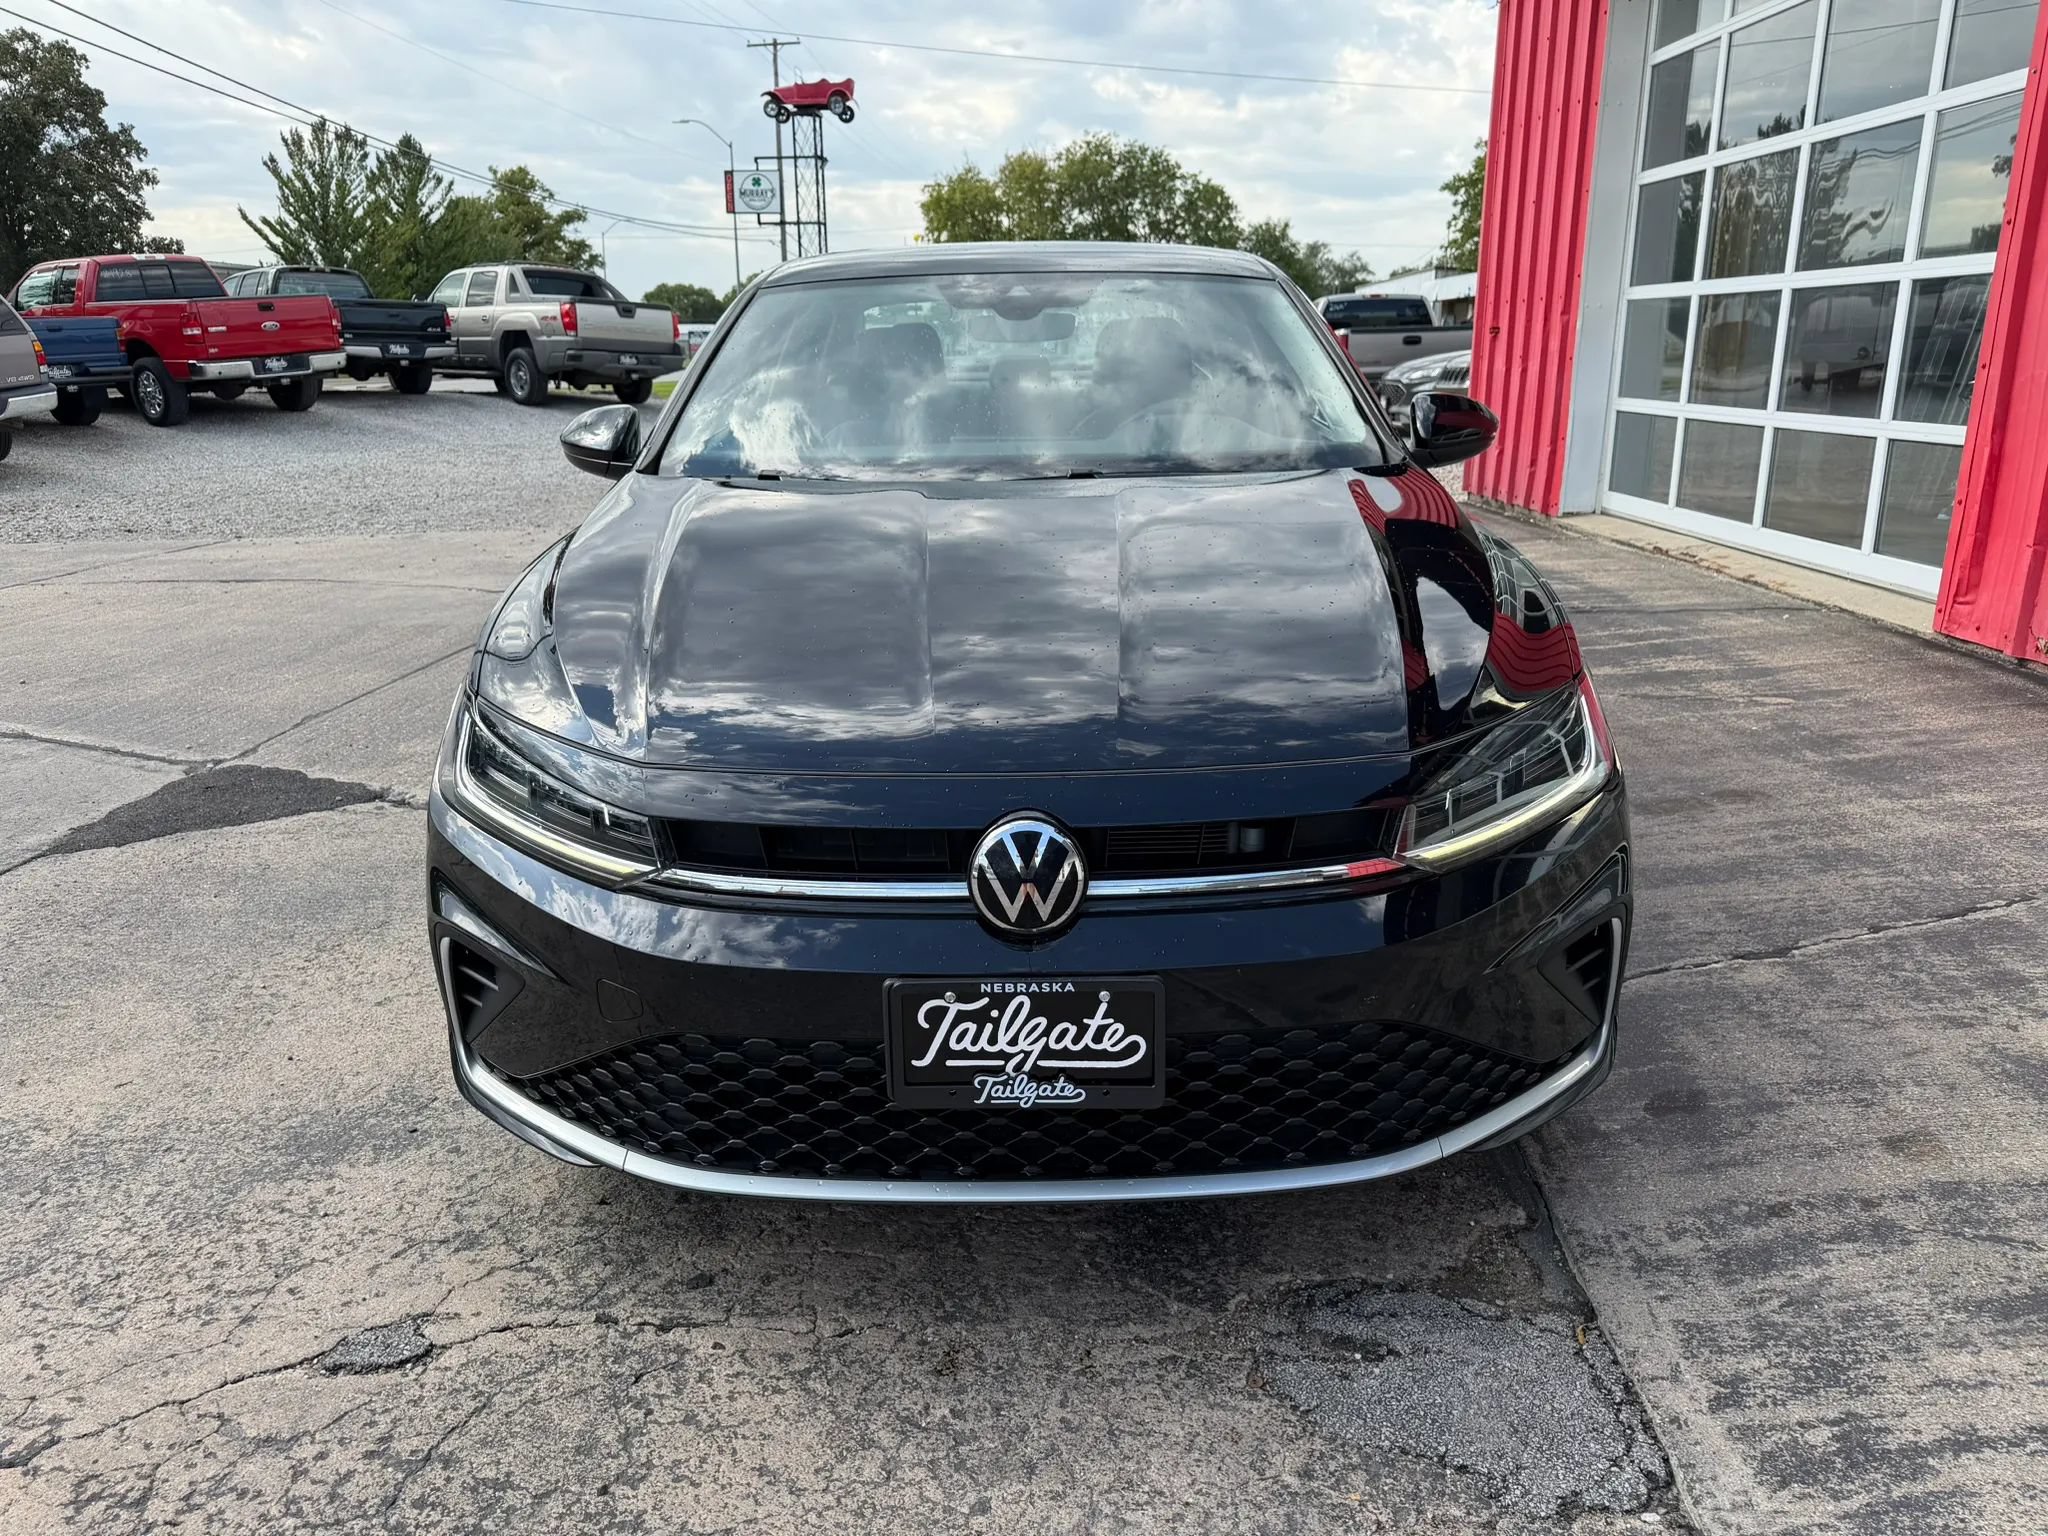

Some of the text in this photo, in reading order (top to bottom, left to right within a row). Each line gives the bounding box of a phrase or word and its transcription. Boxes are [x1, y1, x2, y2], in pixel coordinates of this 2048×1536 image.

[972, 822, 1083, 929] VW
[981, 982, 1075, 993] NEBRASKA
[911, 995, 1147, 1075] Tailgate
[974, 1073, 1086, 1108] Tailgate
